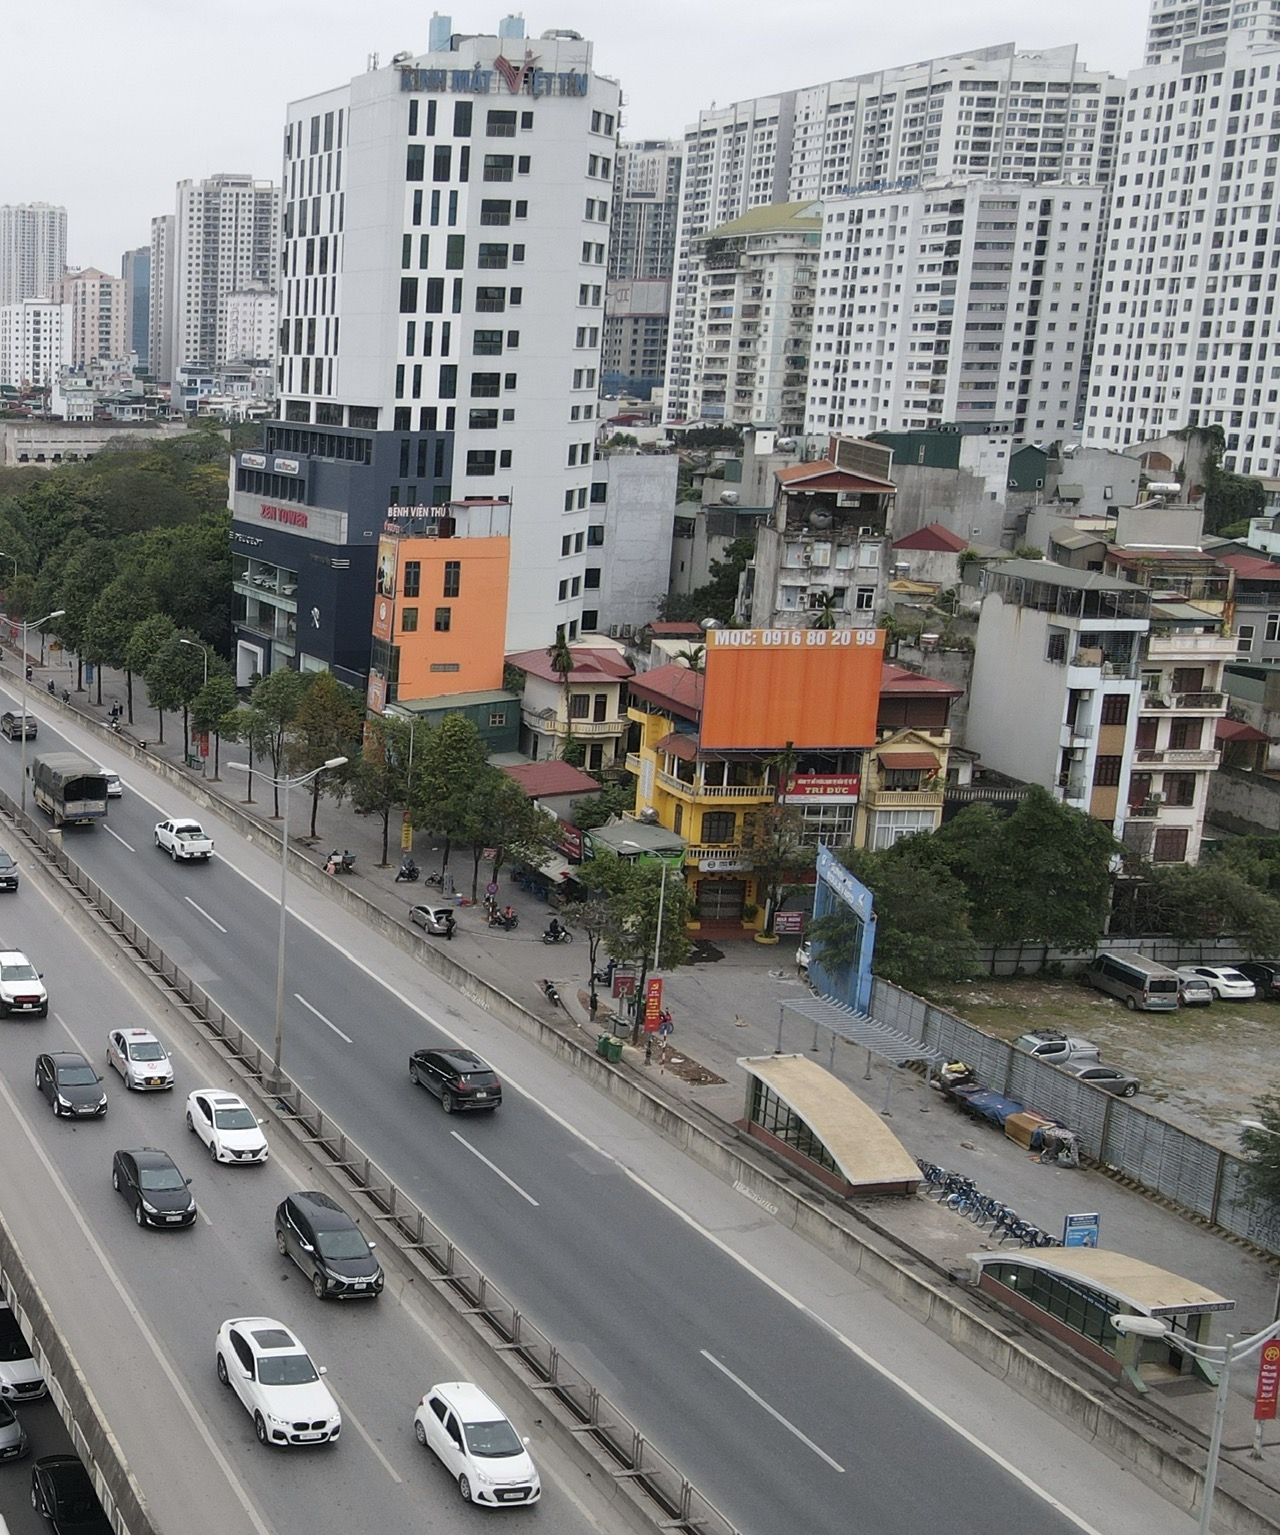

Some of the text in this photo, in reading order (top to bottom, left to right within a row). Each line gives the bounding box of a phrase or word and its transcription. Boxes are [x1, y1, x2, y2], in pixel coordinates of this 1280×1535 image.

[400, 62, 447, 92] KÍNH
[452, 61, 493, 93] MẮT
[559, 68, 588, 96] TÍN
[261, 503, 308, 528] ZEN TOWER
[387, 503, 409, 520] BỆNH
[410, 503, 429, 520] VIỆN
[430, 503, 446, 517] THÚ
[715, 631, 876, 646] MQC: 0916 80 20 99
